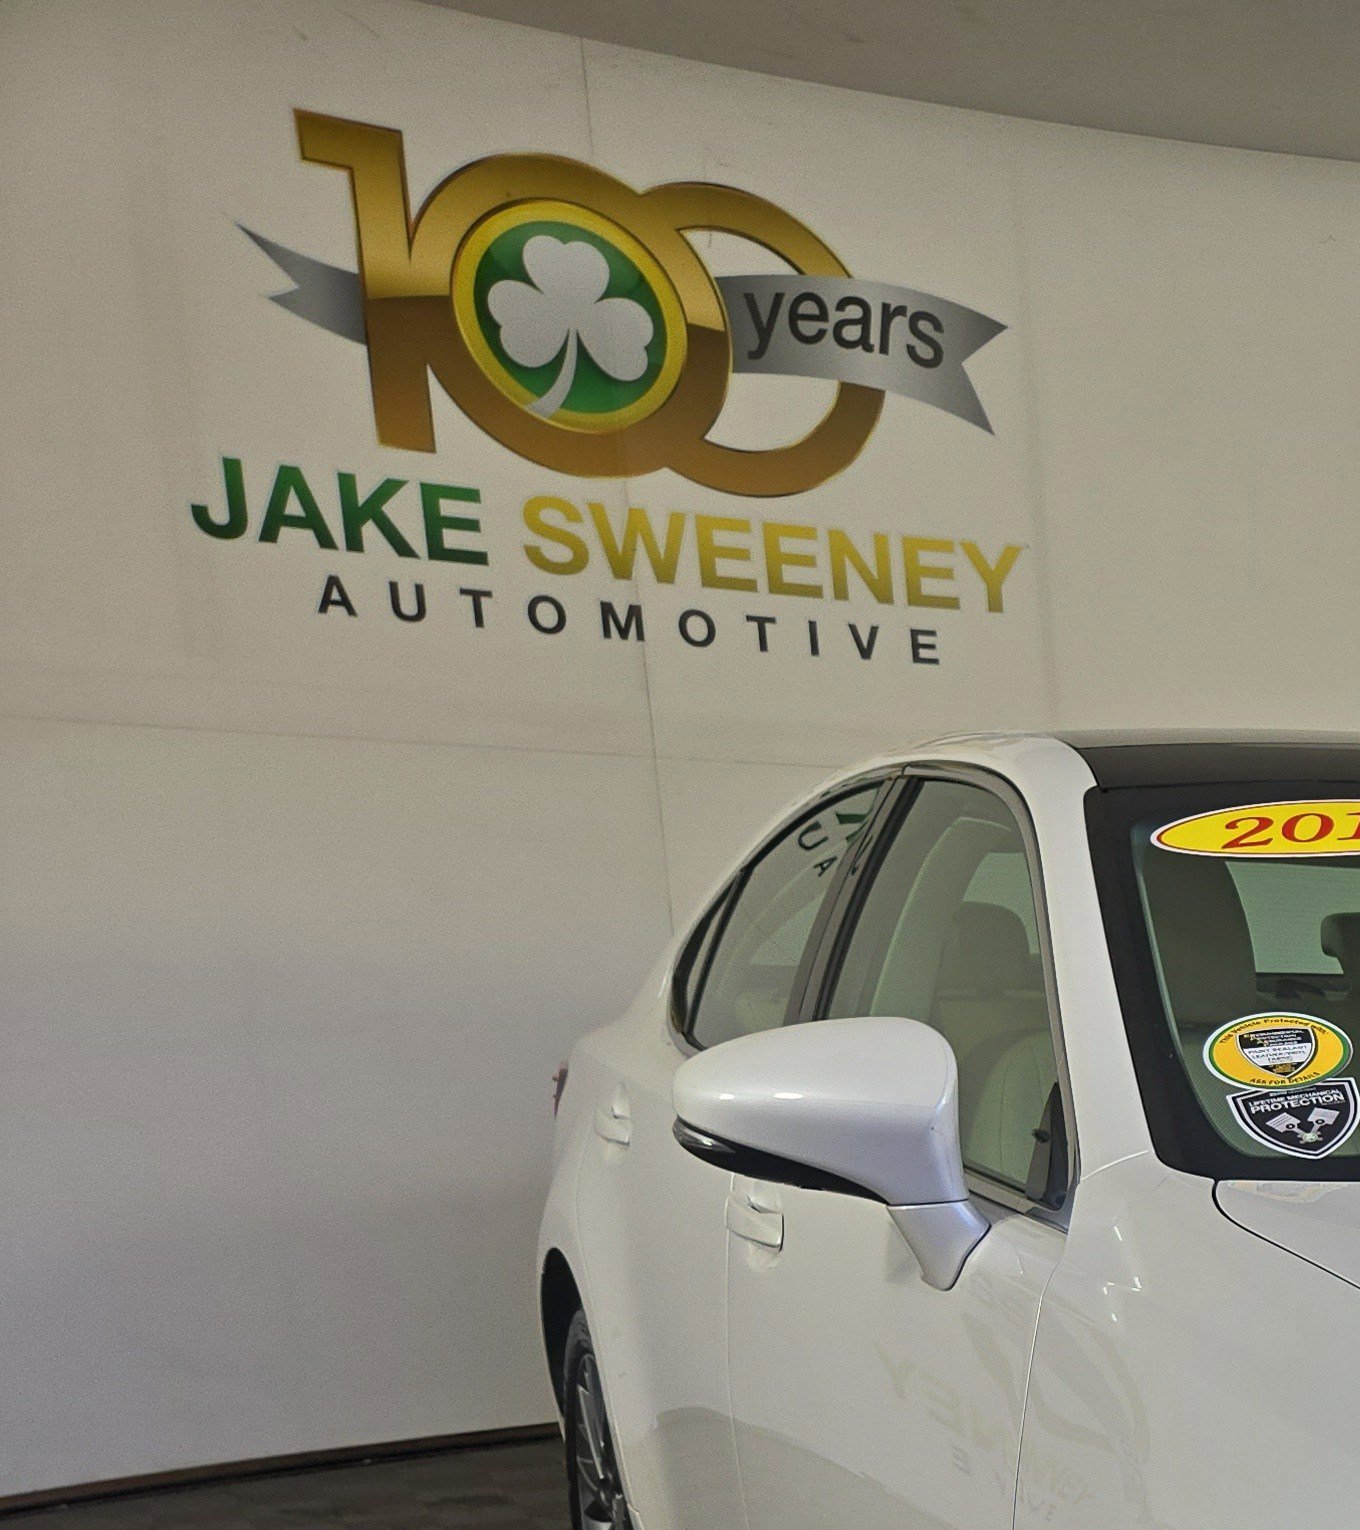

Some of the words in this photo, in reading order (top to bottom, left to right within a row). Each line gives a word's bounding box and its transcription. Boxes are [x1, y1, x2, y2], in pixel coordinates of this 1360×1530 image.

[293, 108, 886, 499] 100
[742, 289, 947, 370] years
[189, 455, 491, 567] JAKE
[521, 493, 1025, 614] SWEENEY
[317, 573, 942, 666] AUTOMOTIVE
[1249, 1096, 1286, 1107] LIFETIME
[1287, 1088, 1341, 1101] MECHANICAL
[1250, 1092, 1346, 1114] PROTECTION
